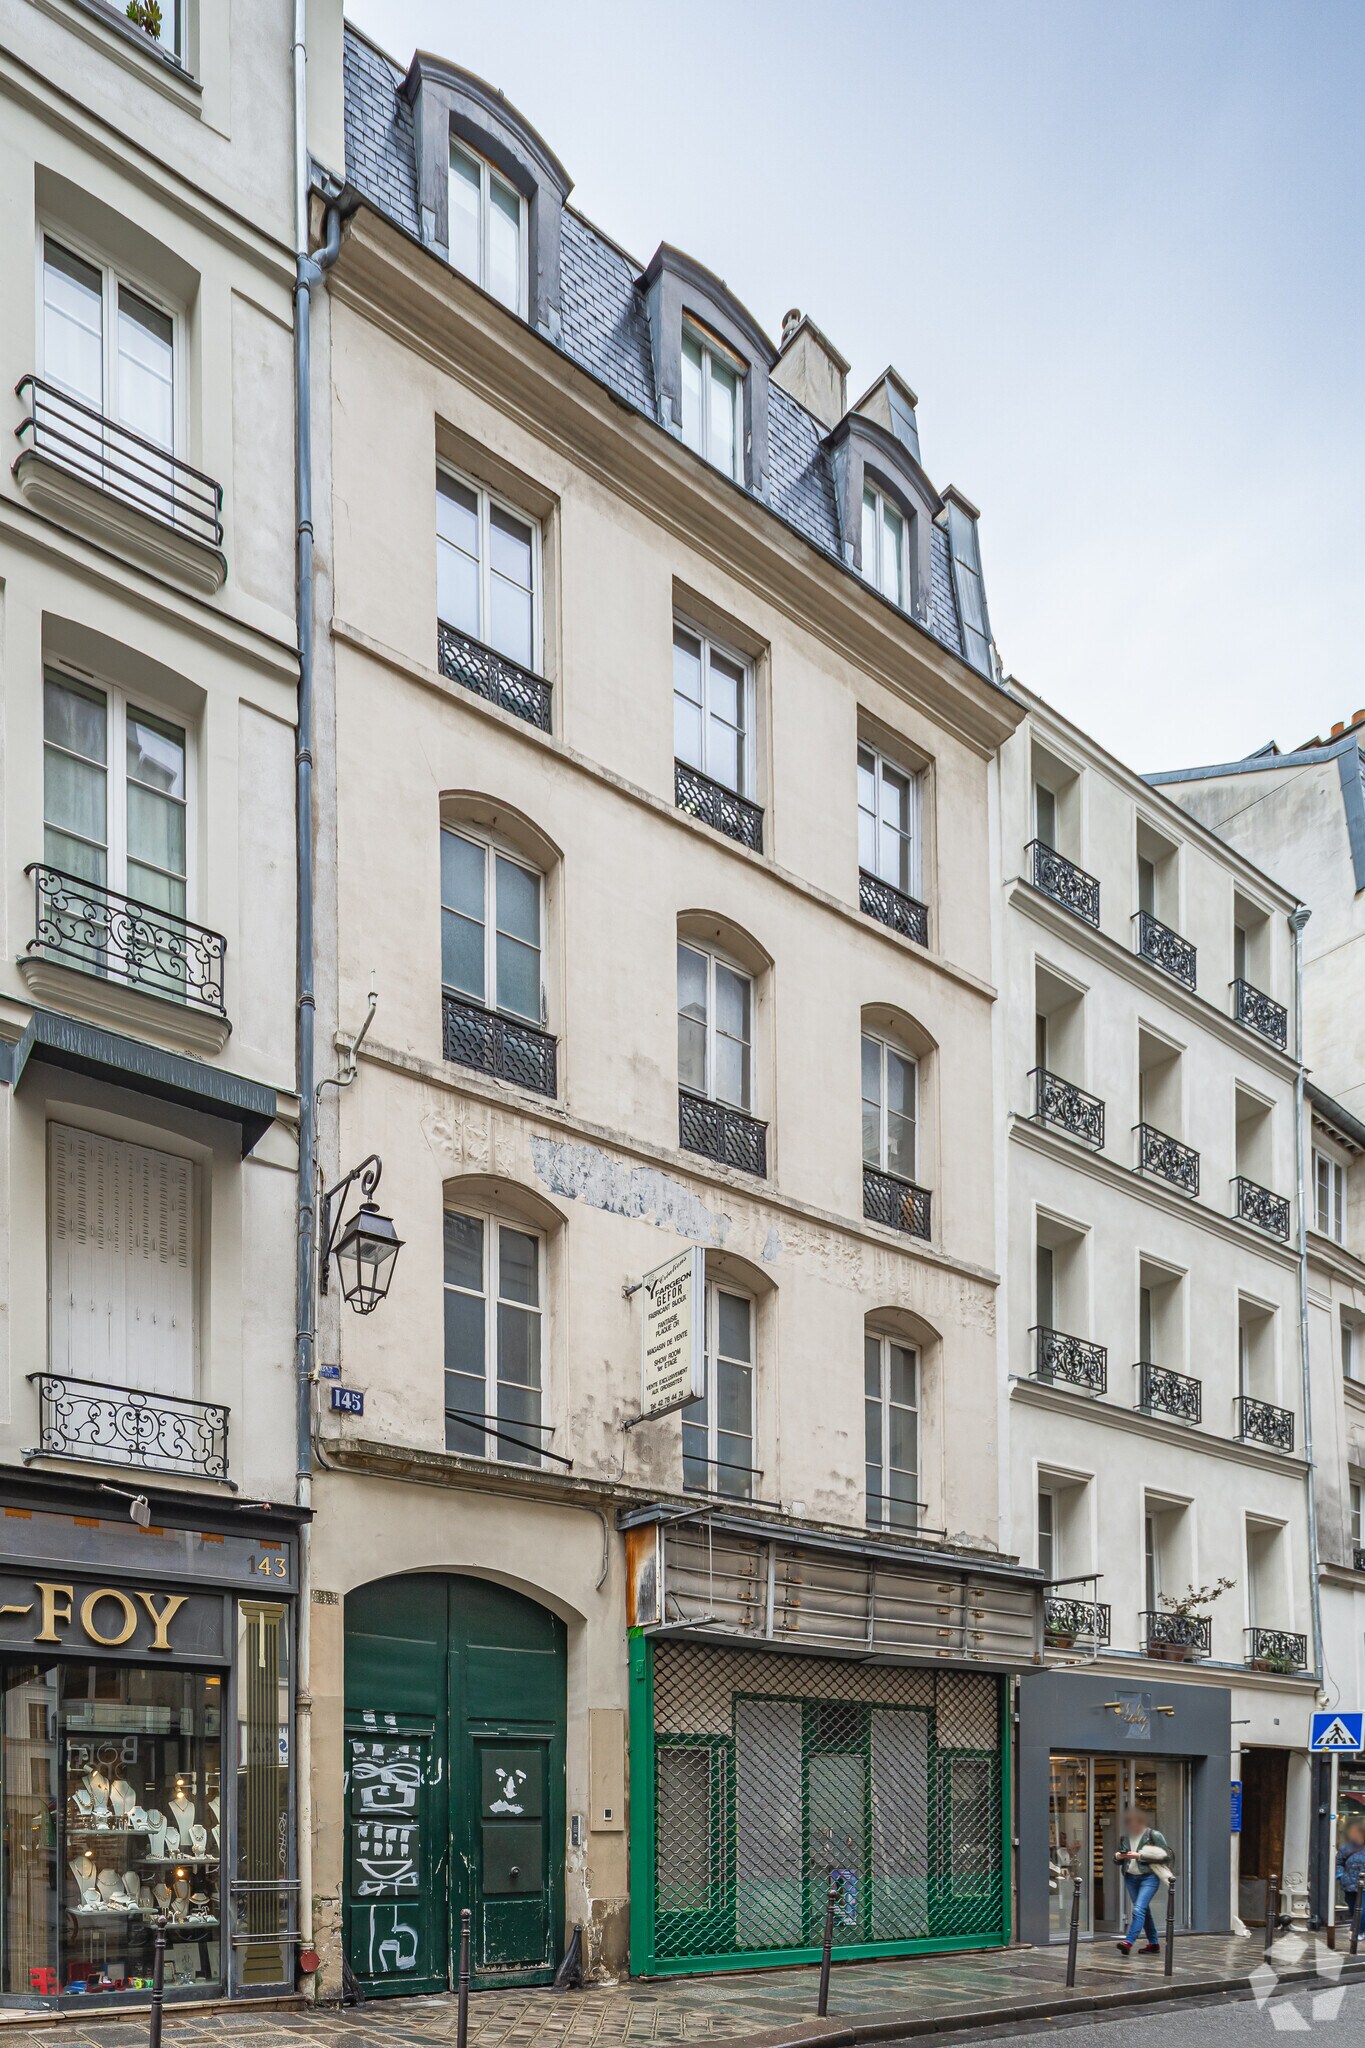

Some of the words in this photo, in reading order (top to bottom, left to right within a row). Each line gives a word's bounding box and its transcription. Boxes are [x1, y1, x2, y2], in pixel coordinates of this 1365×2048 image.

[655, 1270, 692, 1297] FARGEON
[656, 1284, 683, 1307] GEFOR
[648, 1303, 670, 1321] FABRICANT
[671, 1294, 687, 1308] BIJOUX
[657, 1313, 678, 1329] FANTAISIE
[673, 1319, 680, 1329] OR
[646, 1341, 666, 1356] MAGASIN
[666, 1337, 673, 1347] DE
[674, 1329, 688, 1342] VENTE
[654, 1355, 667, 1366] SHOW
[668, 1348, 681, 1360] ROOM
[646, 1380, 658, 1391] VENTE
[659, 1366, 688, 1385] EXCLUSIVEMENT
[651, 1387, 659, 1395] AUX
[660, 1376, 683, 1391] GROSSISTES
[334, 1389, 361, 1411] 145
[247, 1555, 287, 1578] 143
